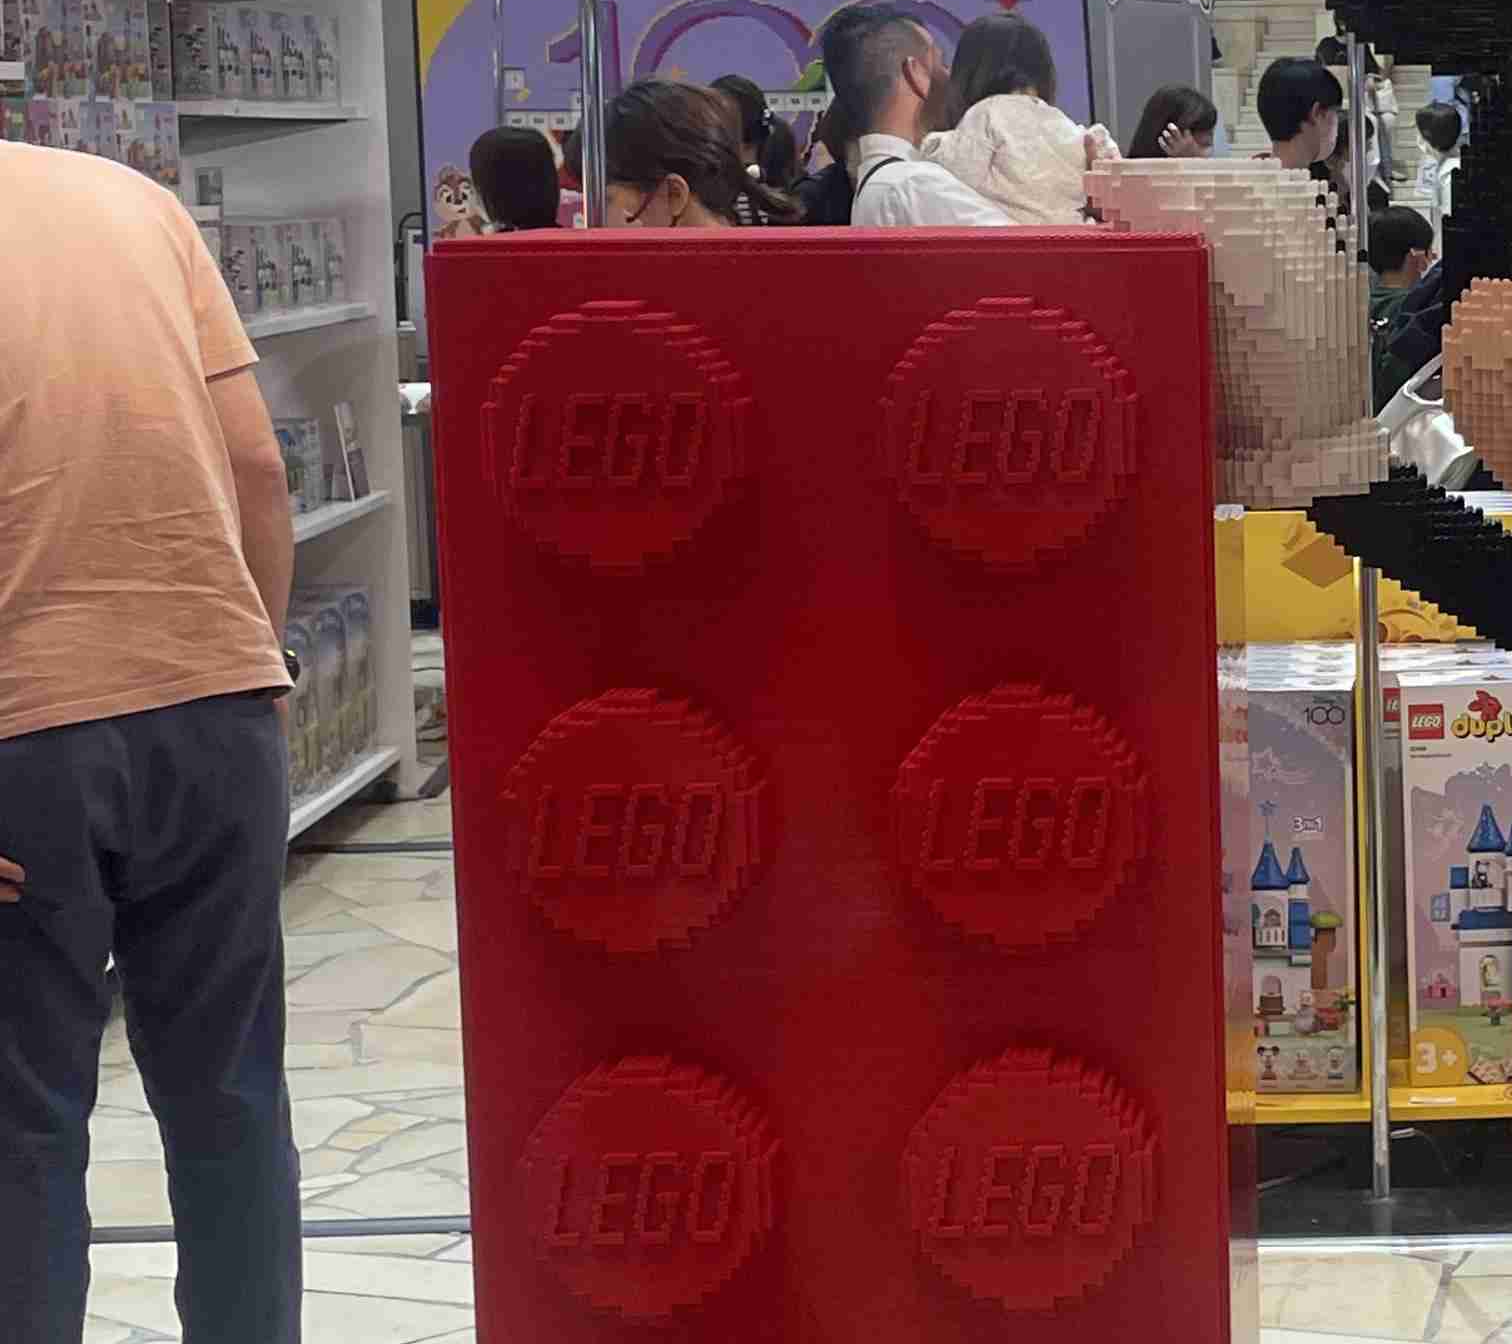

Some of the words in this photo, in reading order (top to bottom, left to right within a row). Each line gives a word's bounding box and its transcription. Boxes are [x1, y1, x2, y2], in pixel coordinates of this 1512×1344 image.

[509, 392, 709, 489] LEGO
[905, 387, 1104, 484] LEGO
[1304, 706, 1346, 725] 100
[1411, 714, 1441, 729] LEGO
[529, 783, 725, 878] LEGO
[920, 776, 1116, 871] LEGO
[1415, 1040, 1458, 1074] 3+
[544, 1151, 738, 1246] LEGO
[929, 1143, 1121, 1237] LEGO
